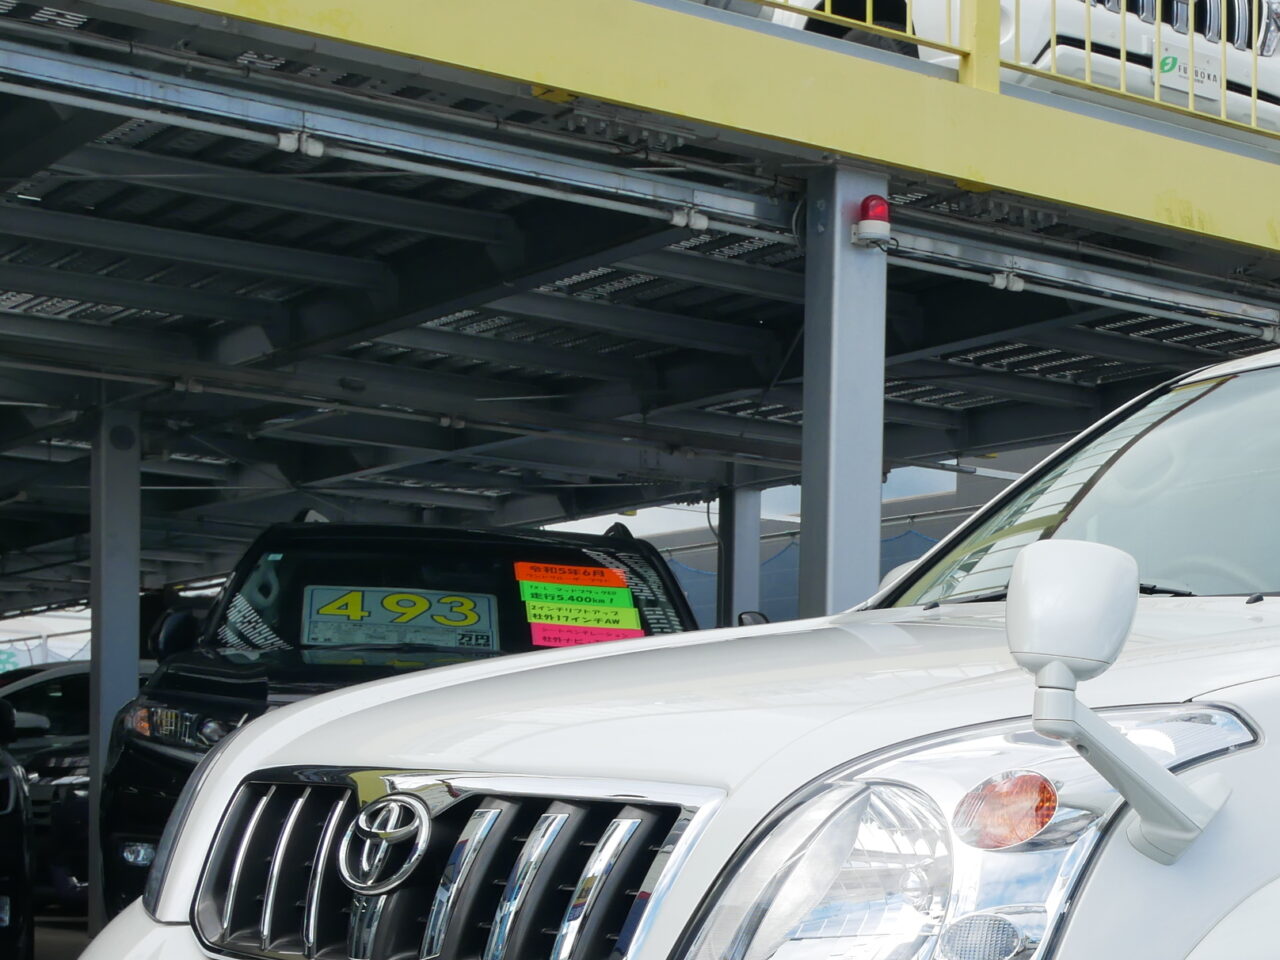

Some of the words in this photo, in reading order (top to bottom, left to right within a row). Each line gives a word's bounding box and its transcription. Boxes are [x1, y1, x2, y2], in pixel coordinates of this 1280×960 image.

[1178, 64, 1218, 83] FUUOKA
[317, 590, 481, 627] 493
[457, 633, 491, 644] 万円
